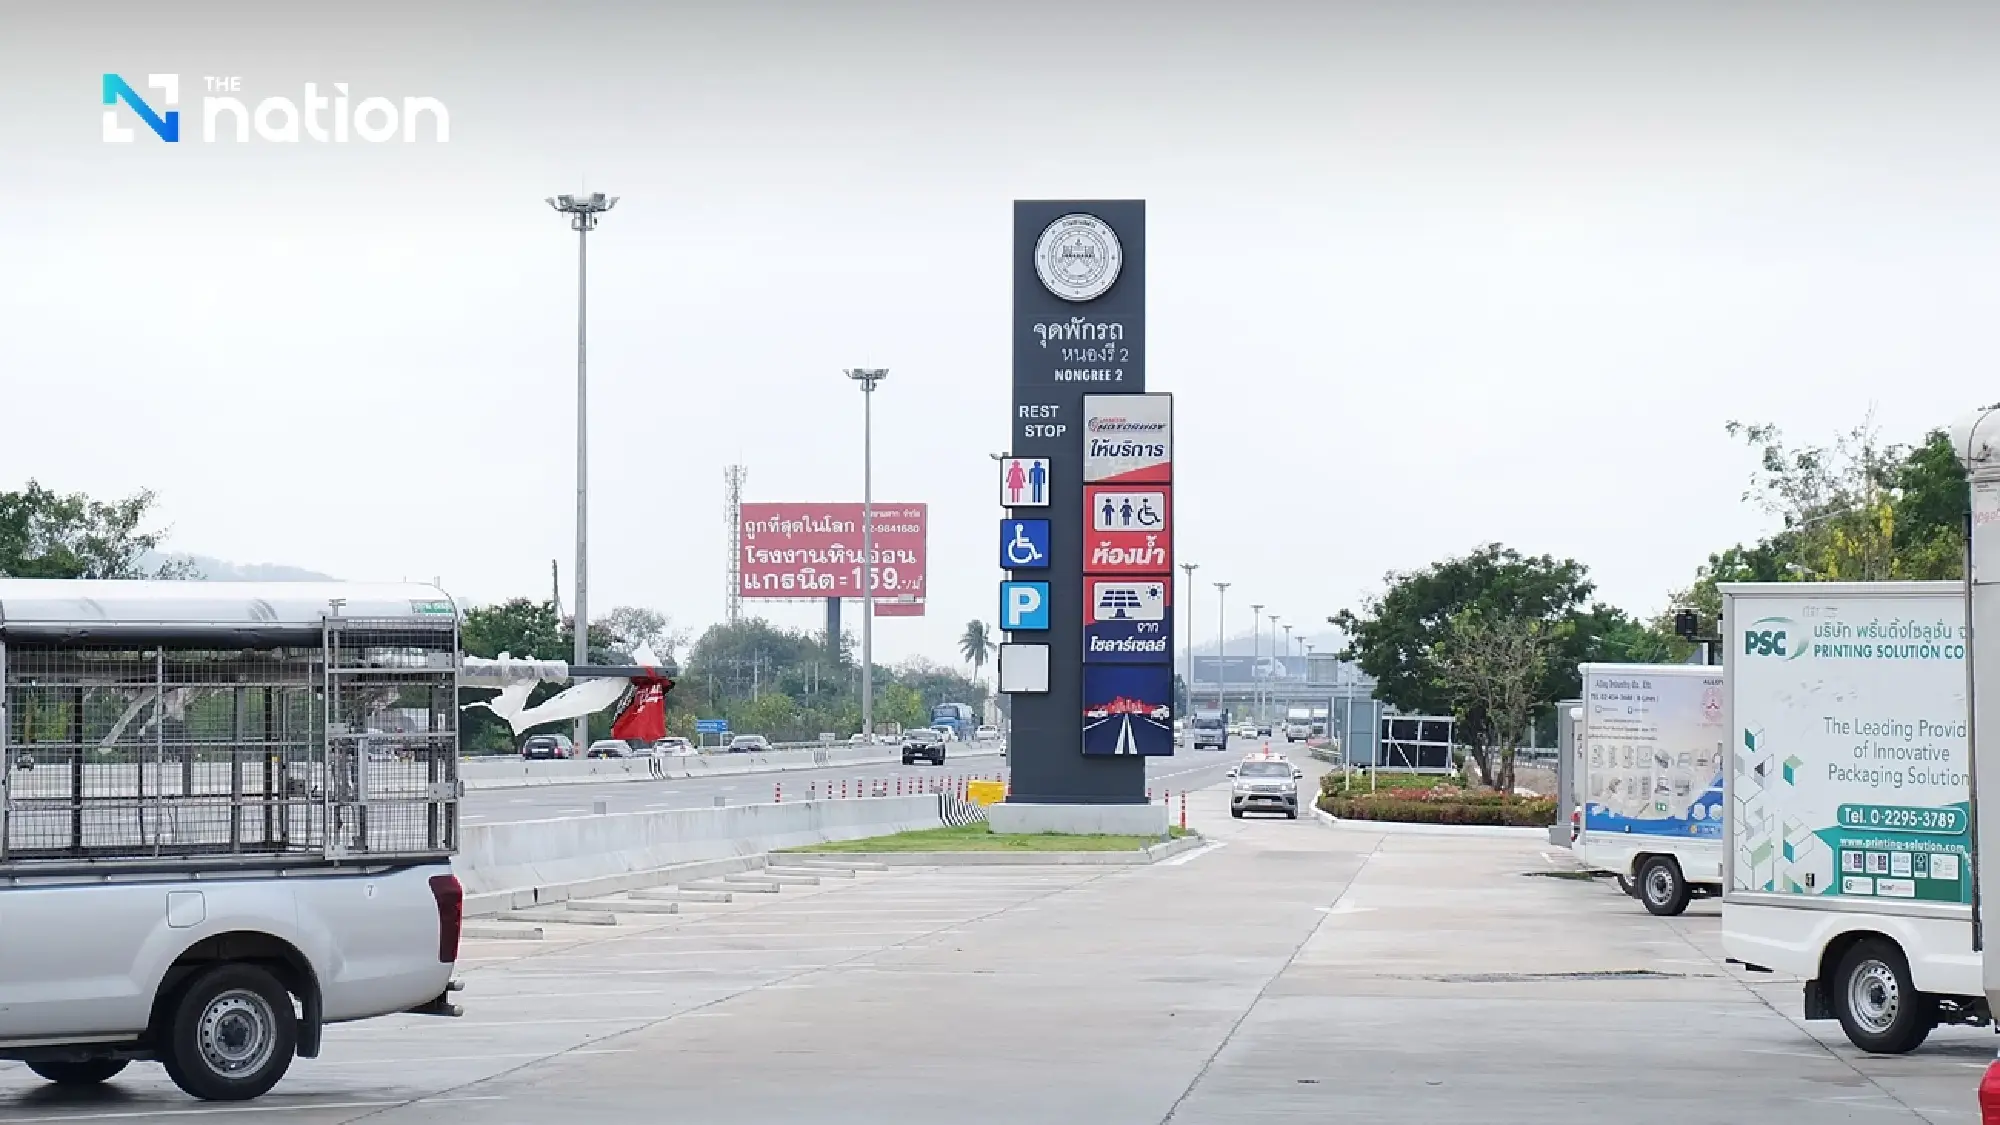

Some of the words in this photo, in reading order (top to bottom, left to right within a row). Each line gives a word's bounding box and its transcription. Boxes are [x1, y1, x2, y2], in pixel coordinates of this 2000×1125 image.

[1033, 317, 1123, 348] จุดพักรถ
[1062, 342, 1115, 362] หนองรี
[1120, 348, 1129, 362] 2
[1054, 369, 1111, 381] NONGREE
[1115, 369, 1123, 381] 2
[1019, 405, 1059, 417] REST
[1025, 425, 1066, 437] STOP
[1091, 439, 1164, 457] ให้บริการ
[745, 514, 855, 539] ถูกที่สุดในโลก
[745, 543, 916, 564] โรงงานหินอ่อน
[1092, 535, 1165, 565] ห้องน้ำ
[1009, 587, 1041, 625] P
[1137, 622, 1158, 633] จาก
[1814, 621, 1851, 638] บริษัท
[1090, 636, 1167, 651] โซลาร์เซลล์
[1745, 630, 1786, 656] PSC
[1814, 644, 1874, 658] PRINTING
[1877, 645, 1939, 659] SOLUTION
[1823, 716, 1850, 735] The
[1854, 718, 1913, 742] Leading
[1854, 740, 1868, 758] of
[1874, 741, 1950, 761] Innovative
[1829, 763, 1903, 789] Packaging
[1845, 808, 1867, 824] Tel.
[1871, 809, 1955, 828] 0-2295-3789
[1840, 837, 1965, 852] www.printing-solution.com
